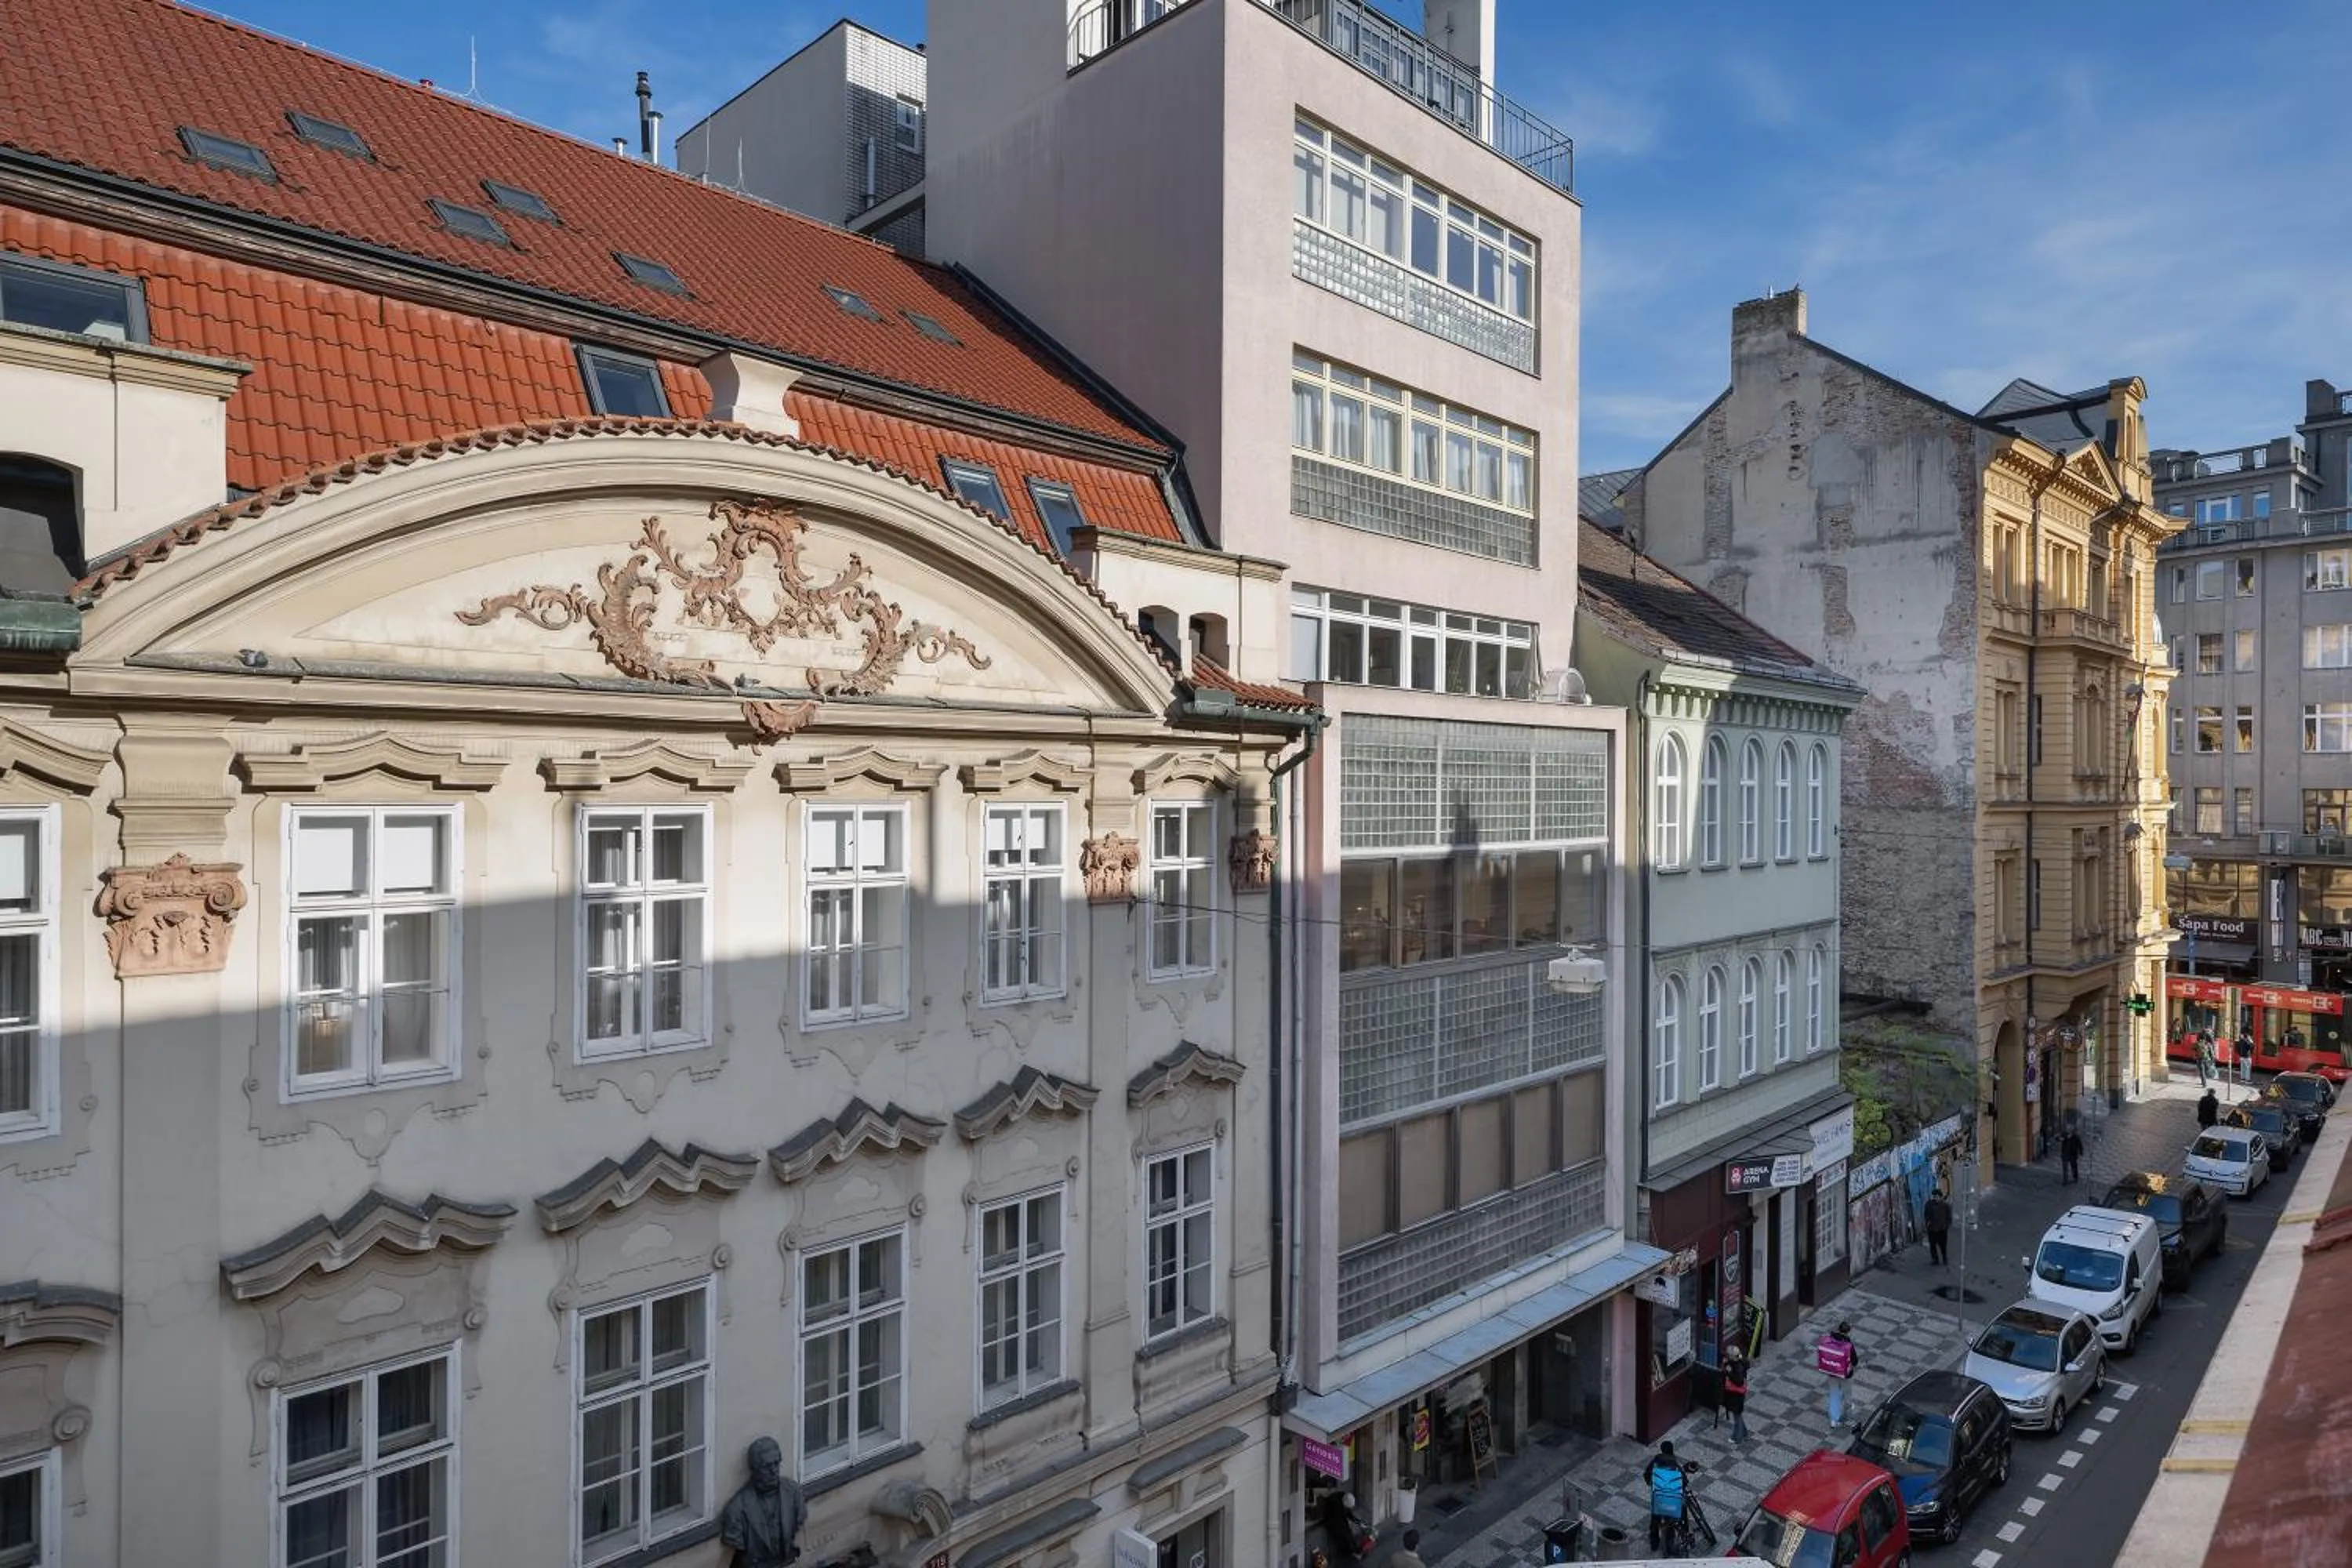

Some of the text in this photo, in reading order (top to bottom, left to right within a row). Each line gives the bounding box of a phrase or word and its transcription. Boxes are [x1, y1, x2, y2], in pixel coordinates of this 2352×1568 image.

[2178, 918, 2245, 934] Sapa Food
[2302, 927, 2323, 946] ABC
[1743, 1174, 1760, 1184] GYM
